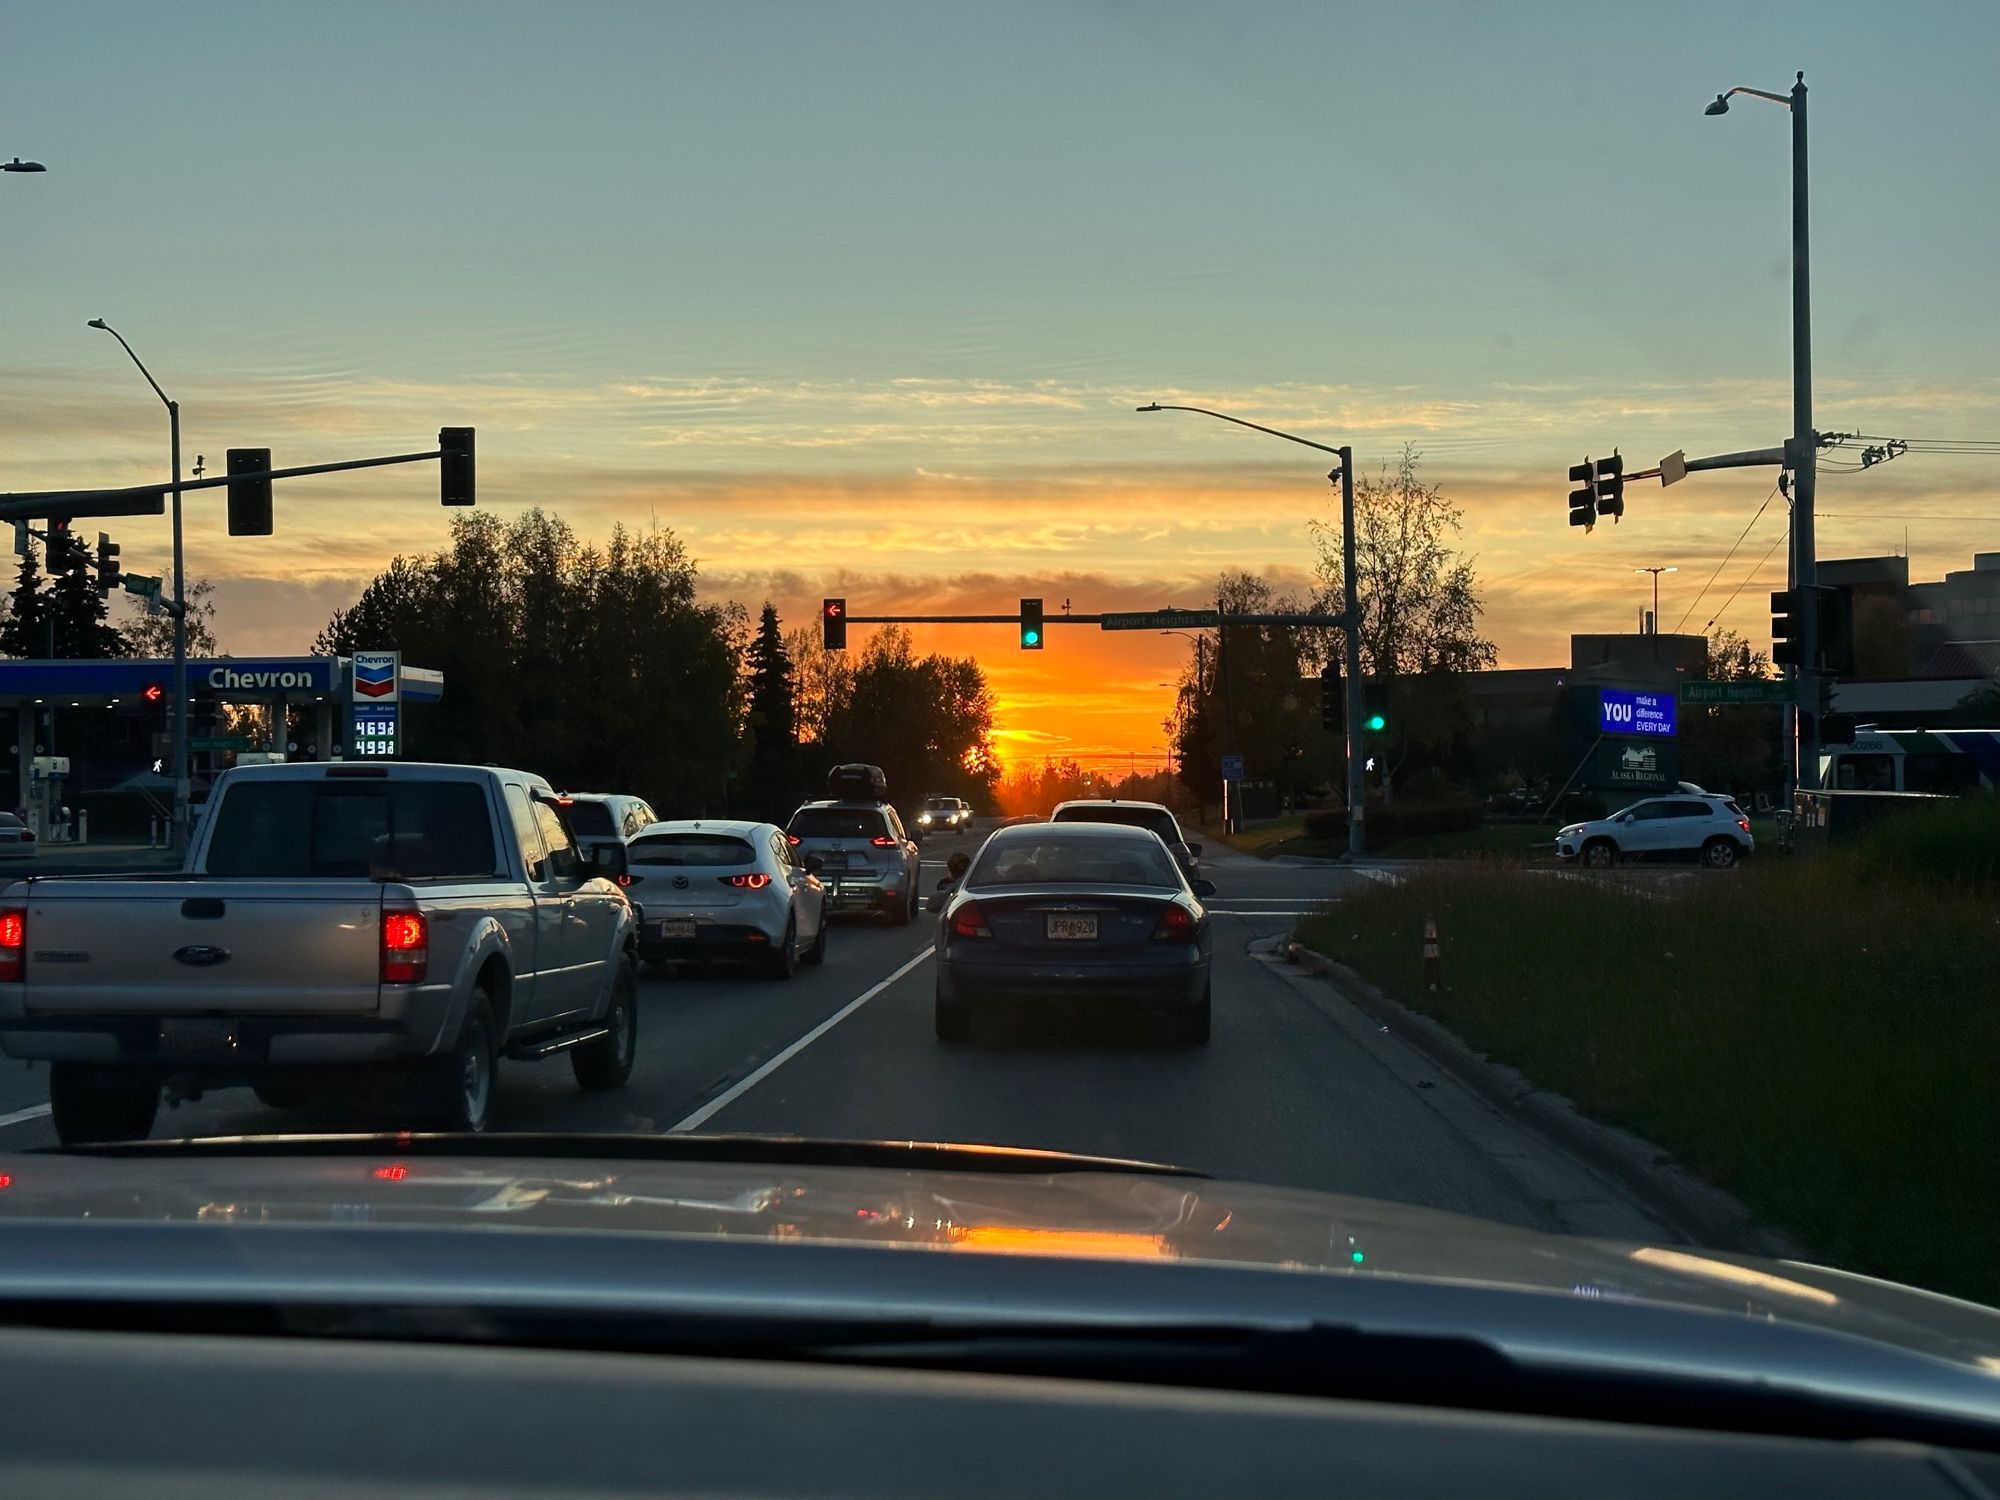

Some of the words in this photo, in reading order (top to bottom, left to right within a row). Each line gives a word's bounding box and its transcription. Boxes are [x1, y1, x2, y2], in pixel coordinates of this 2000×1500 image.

[1106, 615, 1147, 628] Airport
[1152, 613, 1196, 626] Heights
[356, 654, 395, 664] Chevron
[208, 667, 312, 689] Chevron
[1689, 685, 1723, 699] Airport
[1726, 686, 1764, 700] Heights
[1636, 696, 1651, 706] make
[1652, 698, 1657, 706] a
[1603, 702, 1632, 722] YOU
[1636, 709, 1664, 720] difference
[1636, 721, 1657, 733] EVERY
[1658, 722, 1671, 733] DAY
[1611, 769, 1635, 781] ALASKA
[1635, 770, 1667, 782] REGIONAL
